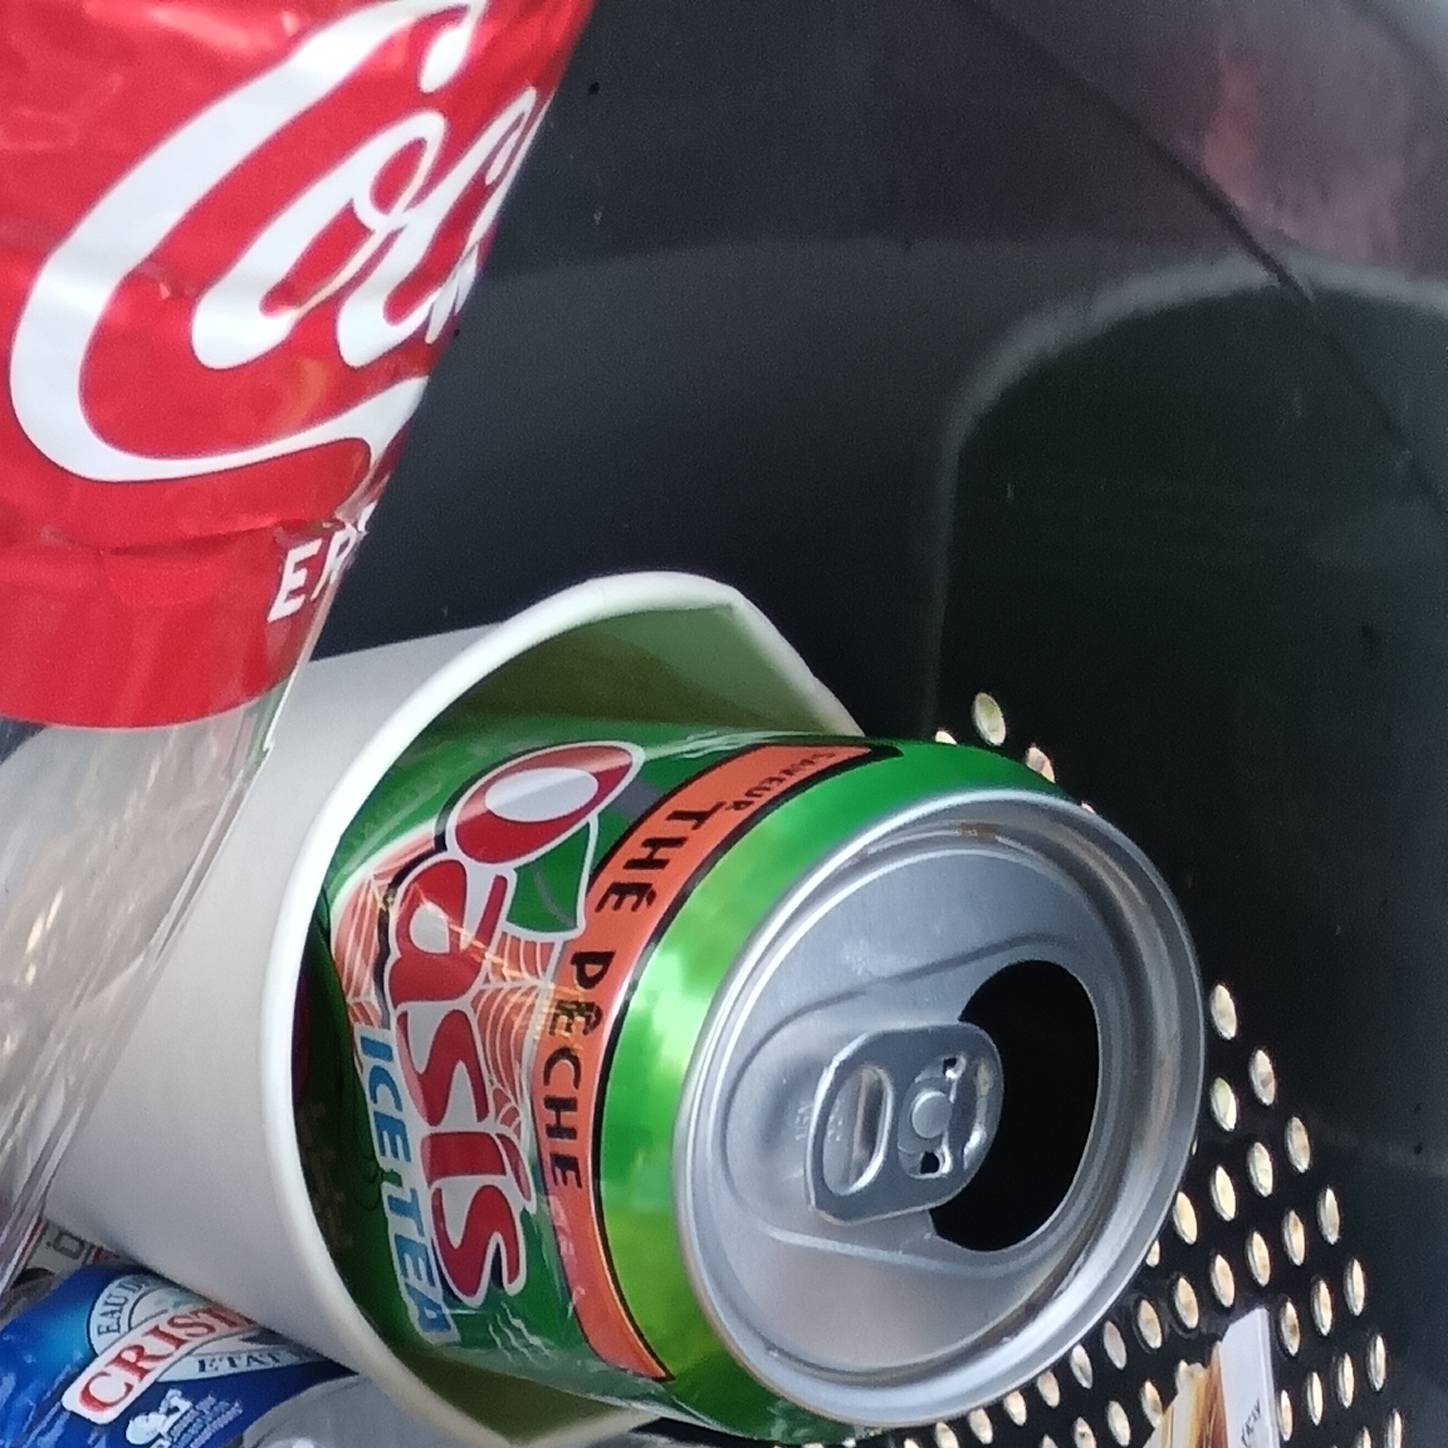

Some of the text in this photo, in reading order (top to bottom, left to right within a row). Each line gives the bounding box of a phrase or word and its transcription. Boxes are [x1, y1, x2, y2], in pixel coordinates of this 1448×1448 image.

[723, 747, 838, 815] SAVEUR
[386, 738, 646, 1308] Oasis
[536, 802, 729, 1190] THÉ PÊCHE
[356, 1032, 455, 1340] ICE TEA
[79, 1303, 259, 1412] CRIST
[97, 1292, 129, 1336] EAU
